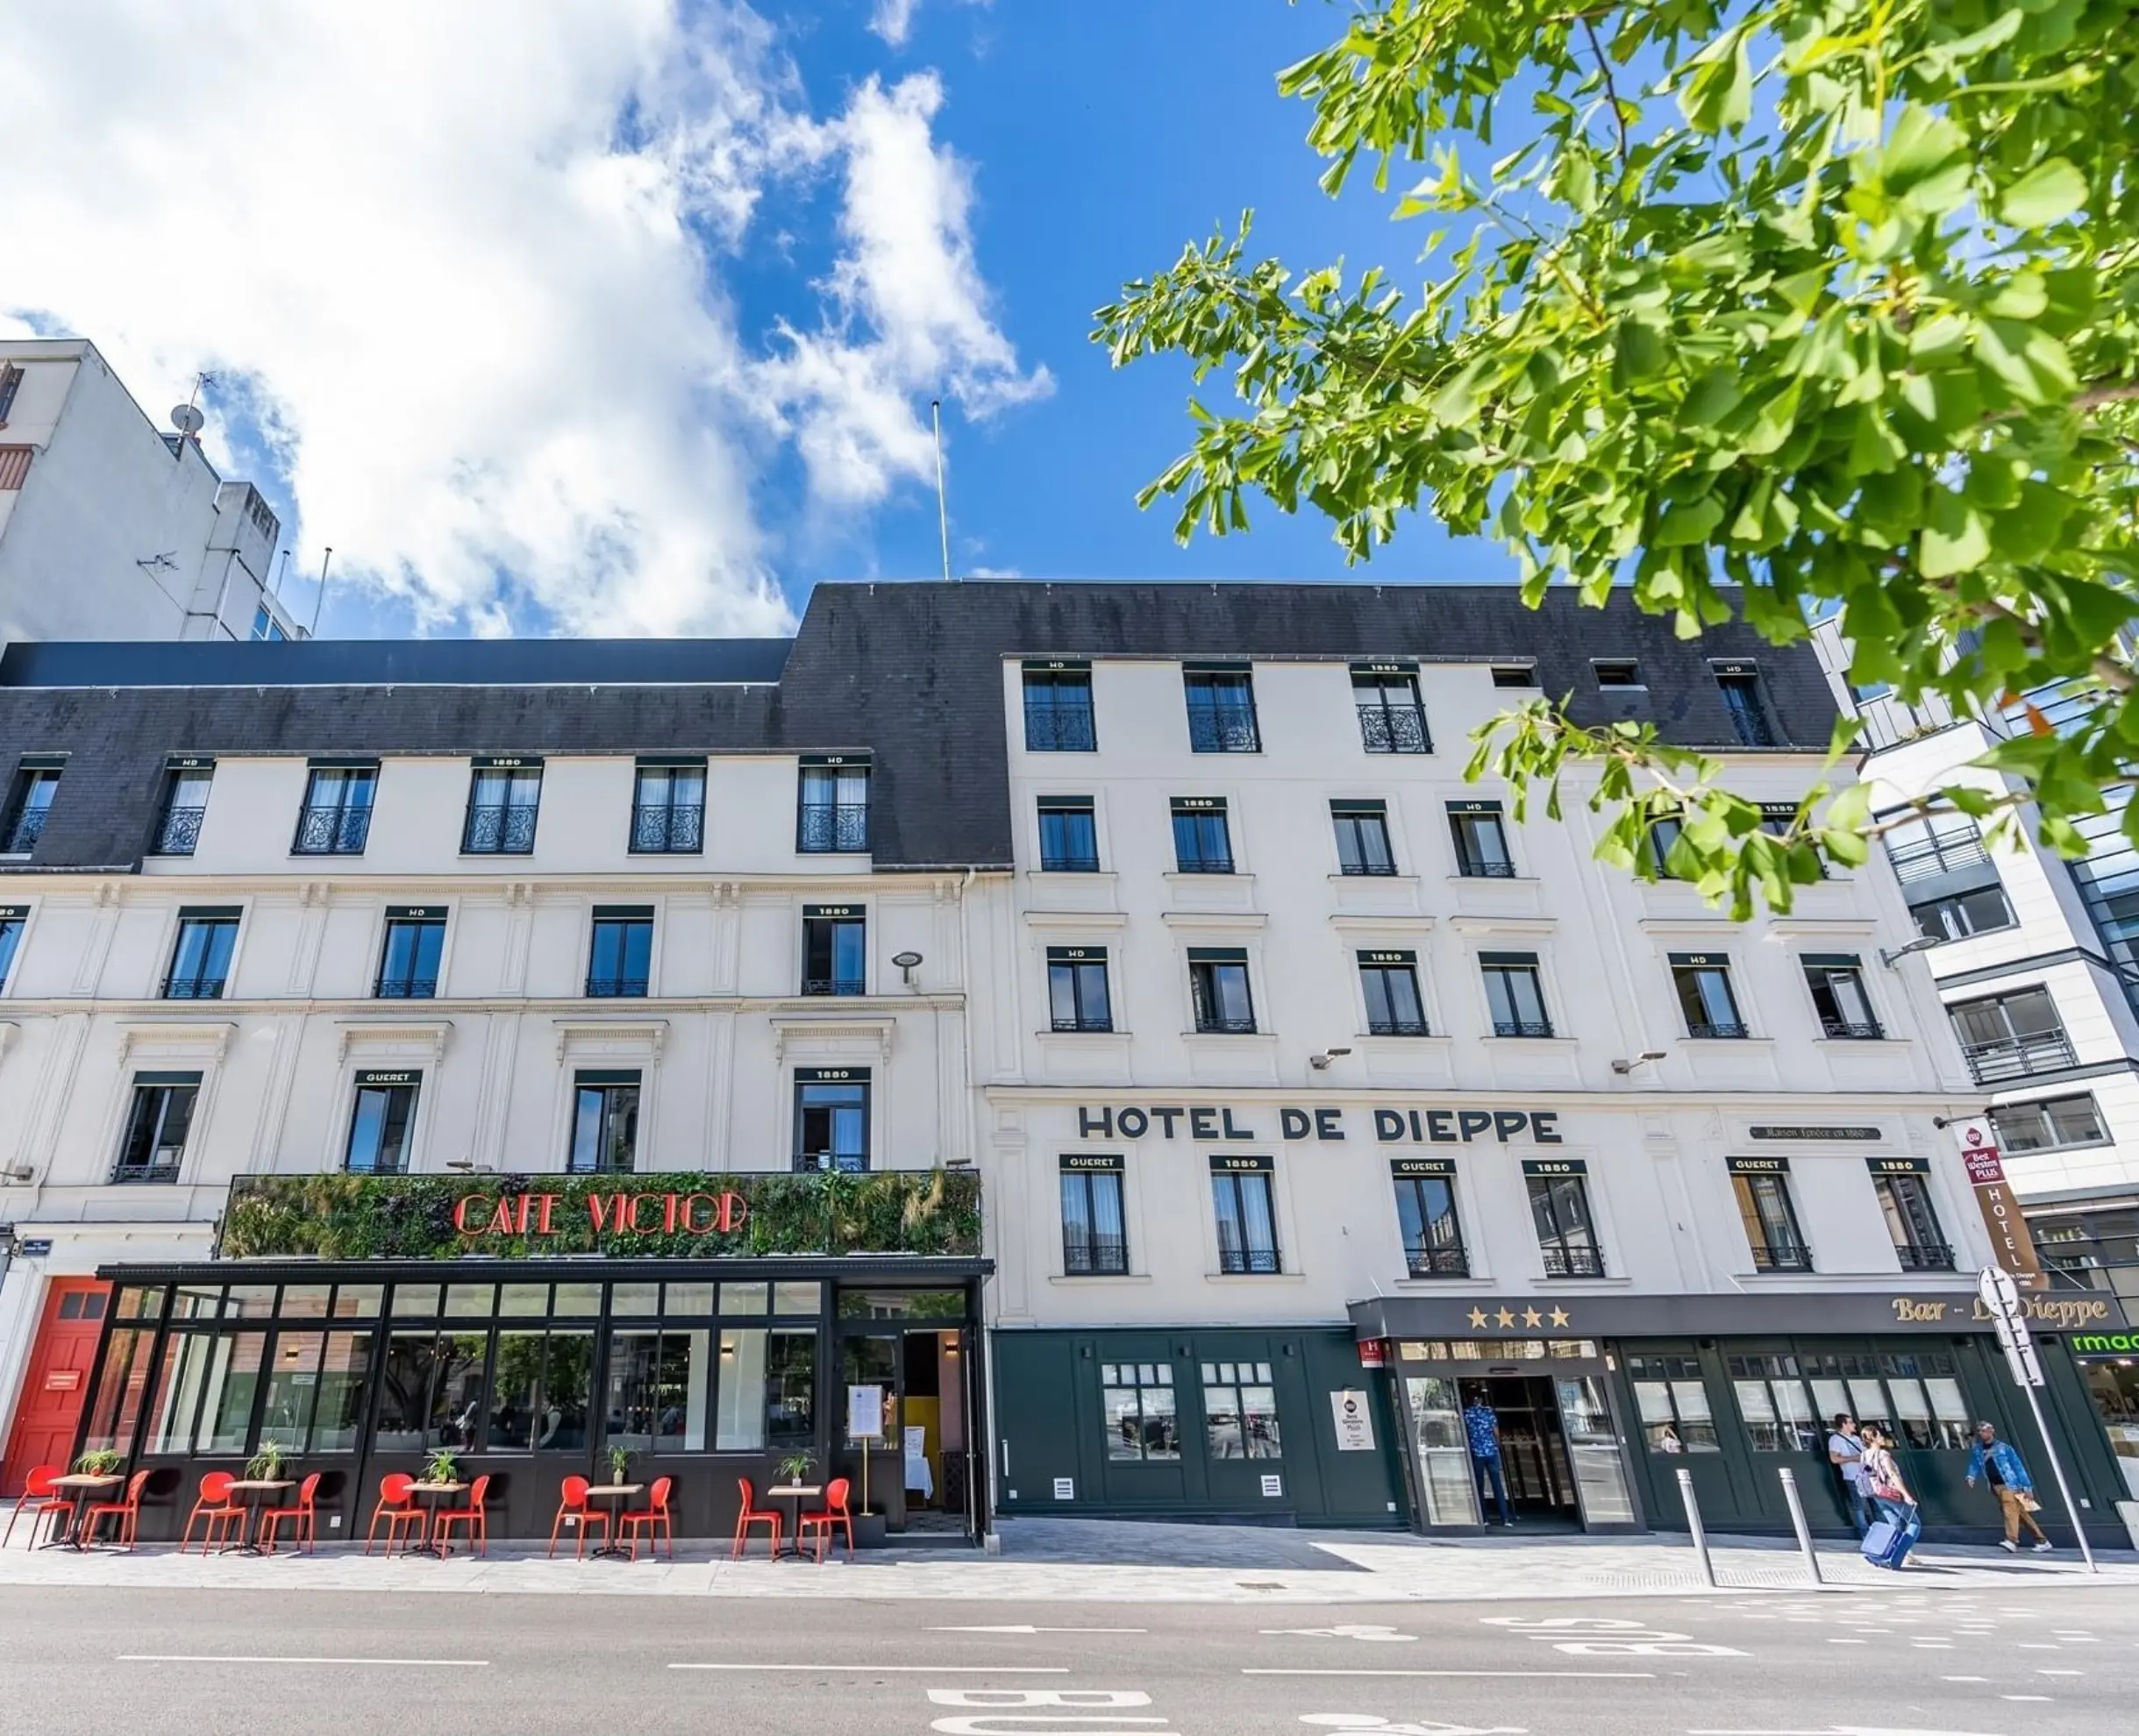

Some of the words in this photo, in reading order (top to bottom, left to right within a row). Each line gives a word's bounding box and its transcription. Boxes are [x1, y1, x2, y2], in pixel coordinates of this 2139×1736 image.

[1690, 956, 1707, 964] HD
[366, 1073, 410, 1082] GUERET
[816, 1070, 849, 1079] 1880
[1079, 1106, 1254, 1140] HOTEL
[1280, 1108, 1345, 1141] DE
[1373, 1109, 1563, 1143] DIEPPE
[1069, 1157, 1115, 1167] GUERET
[1225, 1159, 1258, 1168] 1880
[1736, 1160, 1779, 1169] GUERET
[1880, 1161, 1914, 1170] 1880
[1401, 1163, 1444, 1171] GUERET
[1537, 1163, 1570, 1172] 1880
[1975, 1167, 1998, 1179] PLUS
[453, 1193, 563, 1234] CAFE
[588, 1192, 747, 1234] VICTOR
[1987, 1188, 2021, 1267] HOTEL
[1892, 1298, 1947, 1321] Bar
[2017, 1293, 2109, 1328] Dieppe
